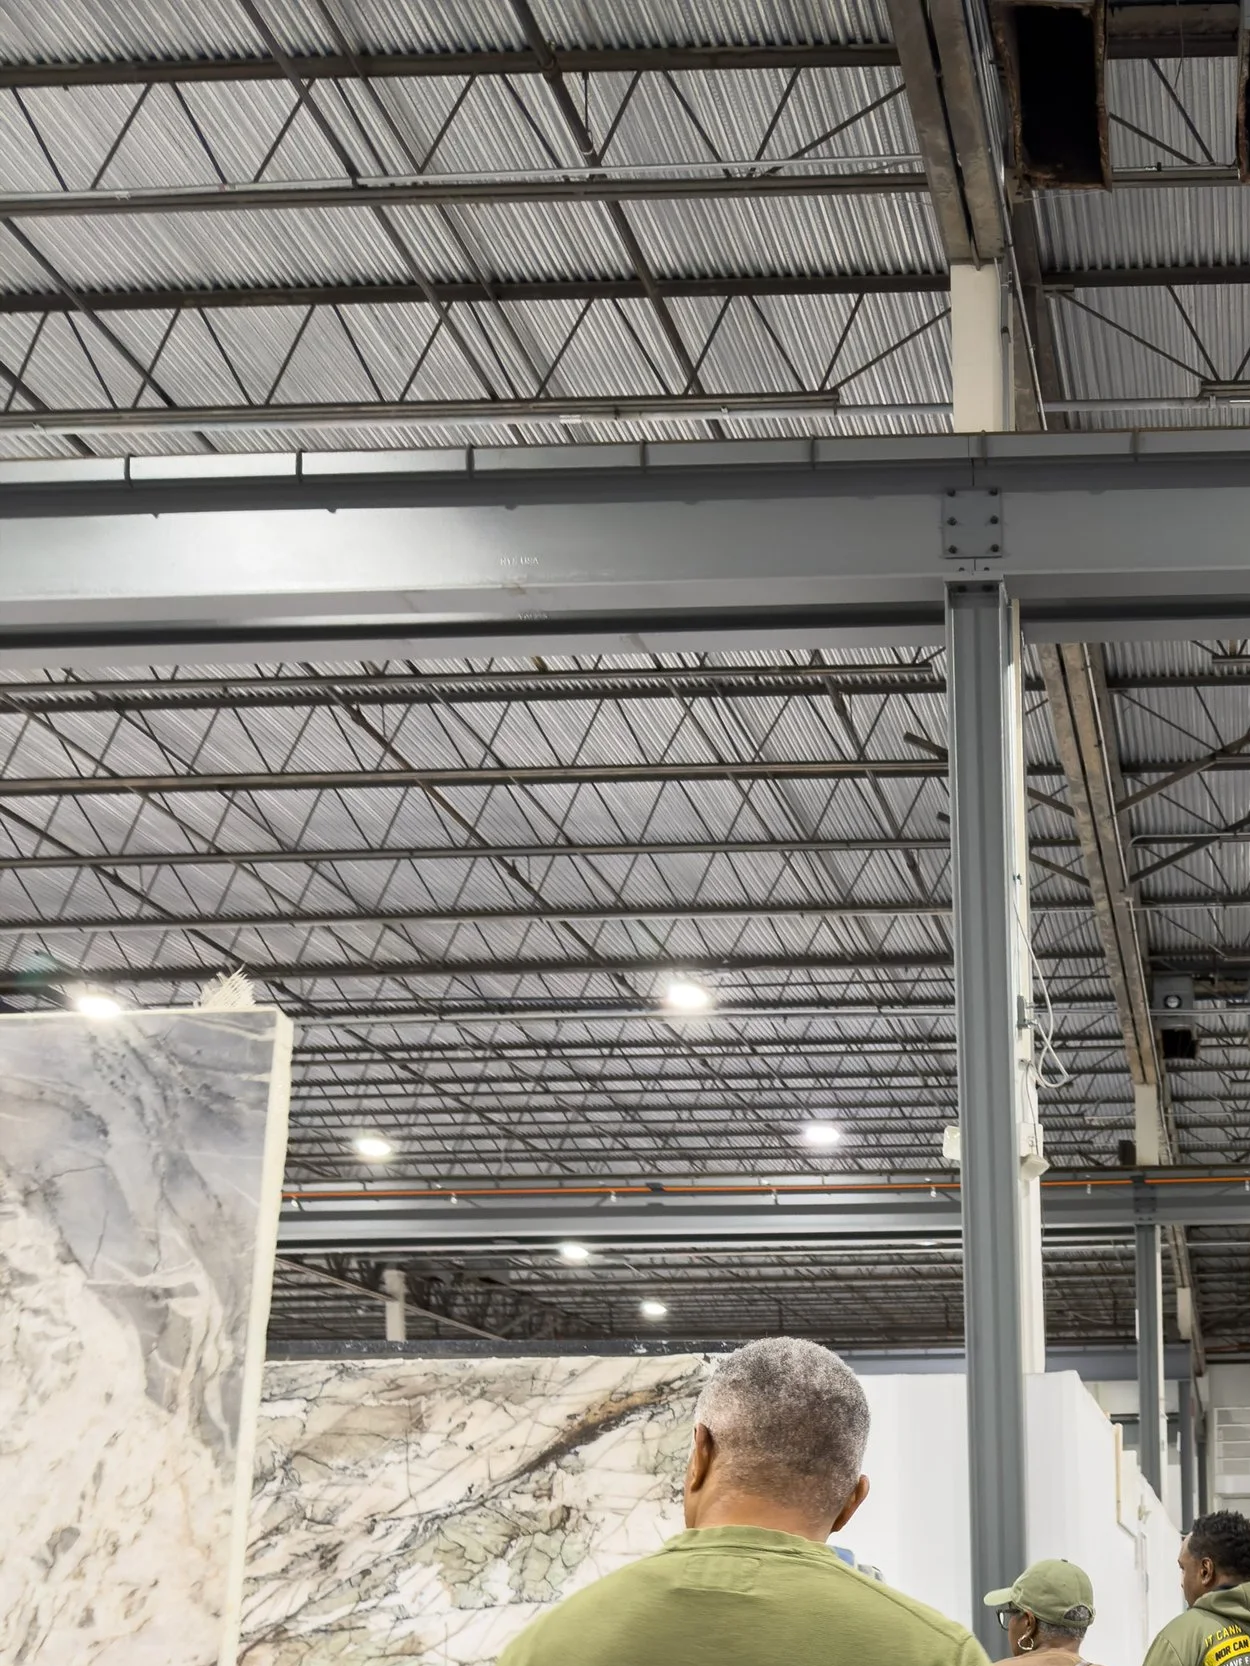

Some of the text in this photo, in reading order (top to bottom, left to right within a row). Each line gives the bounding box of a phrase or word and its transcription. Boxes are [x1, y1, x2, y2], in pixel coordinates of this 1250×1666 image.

[1204, 1634, 1213, 1648] IT
[1216, 1625, 1242, 1640] CANN
[1215, 1645, 1231, 1661] NOR
[1232, 1639, 1249, 1652] CAN
